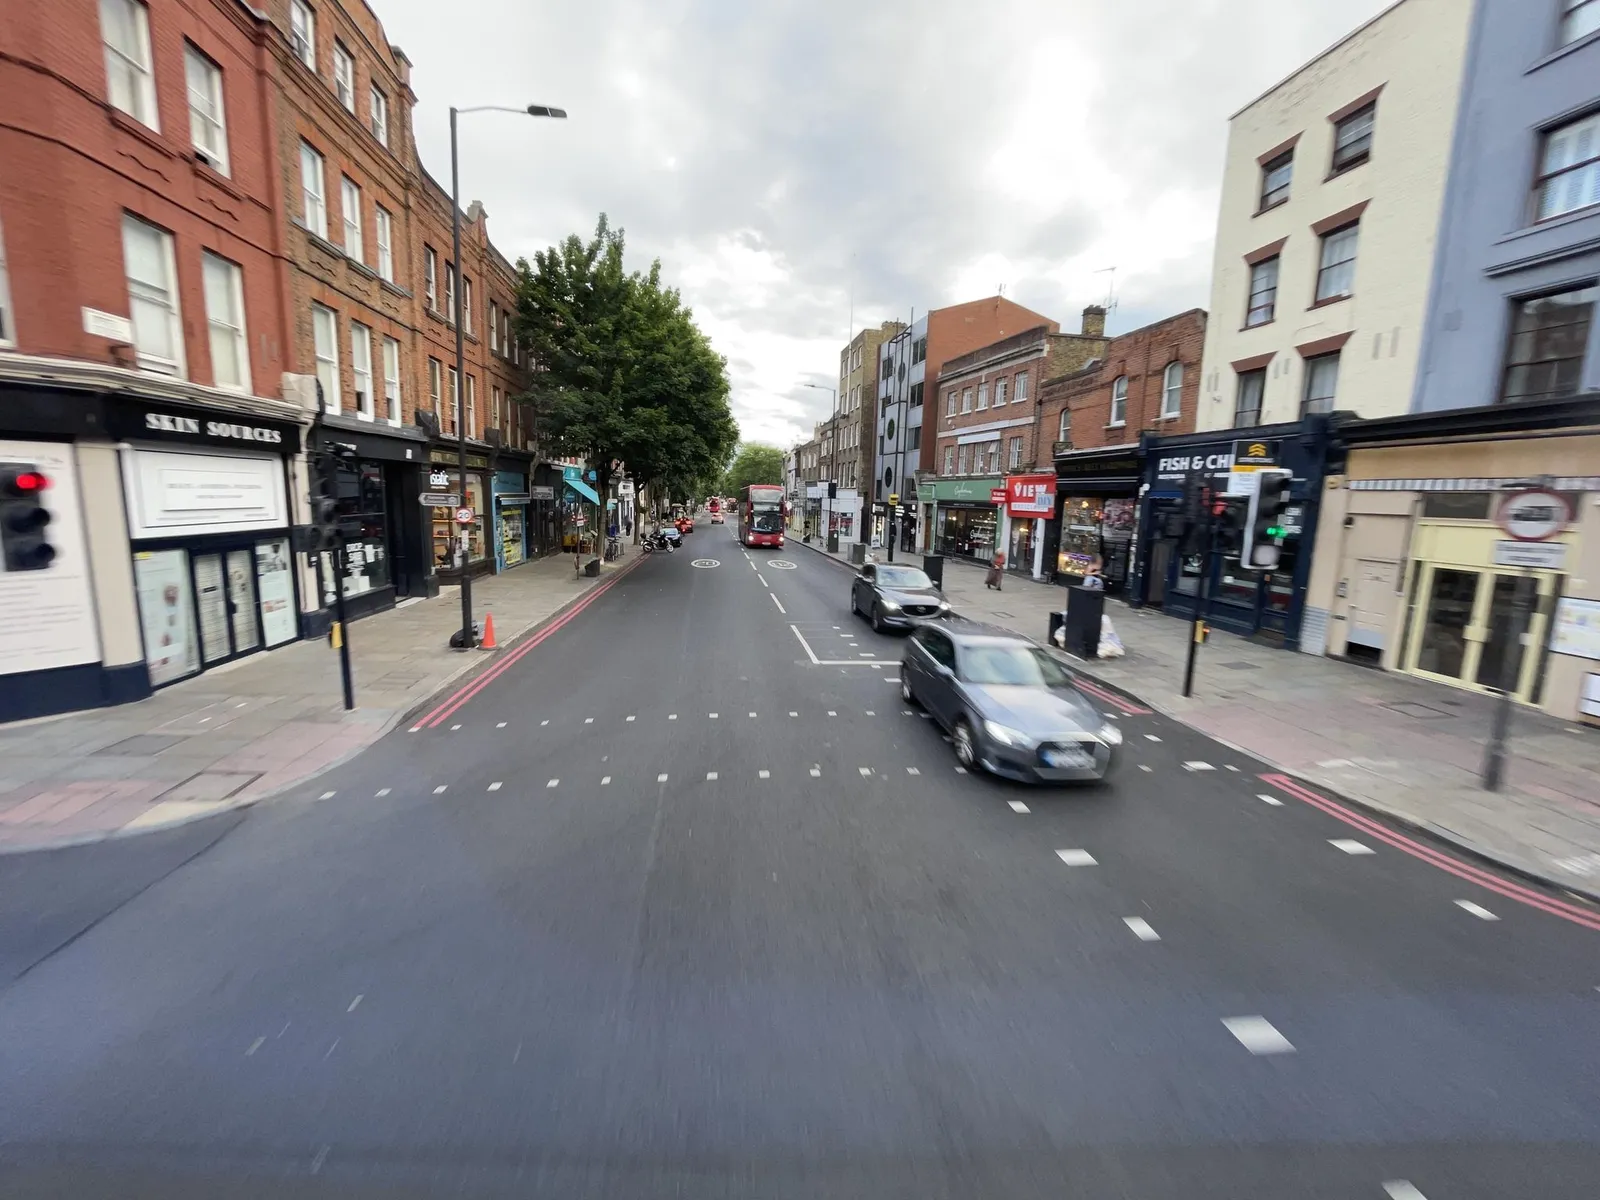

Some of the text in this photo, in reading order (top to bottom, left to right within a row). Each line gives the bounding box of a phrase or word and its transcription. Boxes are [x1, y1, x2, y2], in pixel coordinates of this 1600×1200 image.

[145, 413, 282, 443] SKIN SOURCES
[1158, 453, 1235, 471] FISH & CHI
[1014, 483, 1047, 498] VIEW
